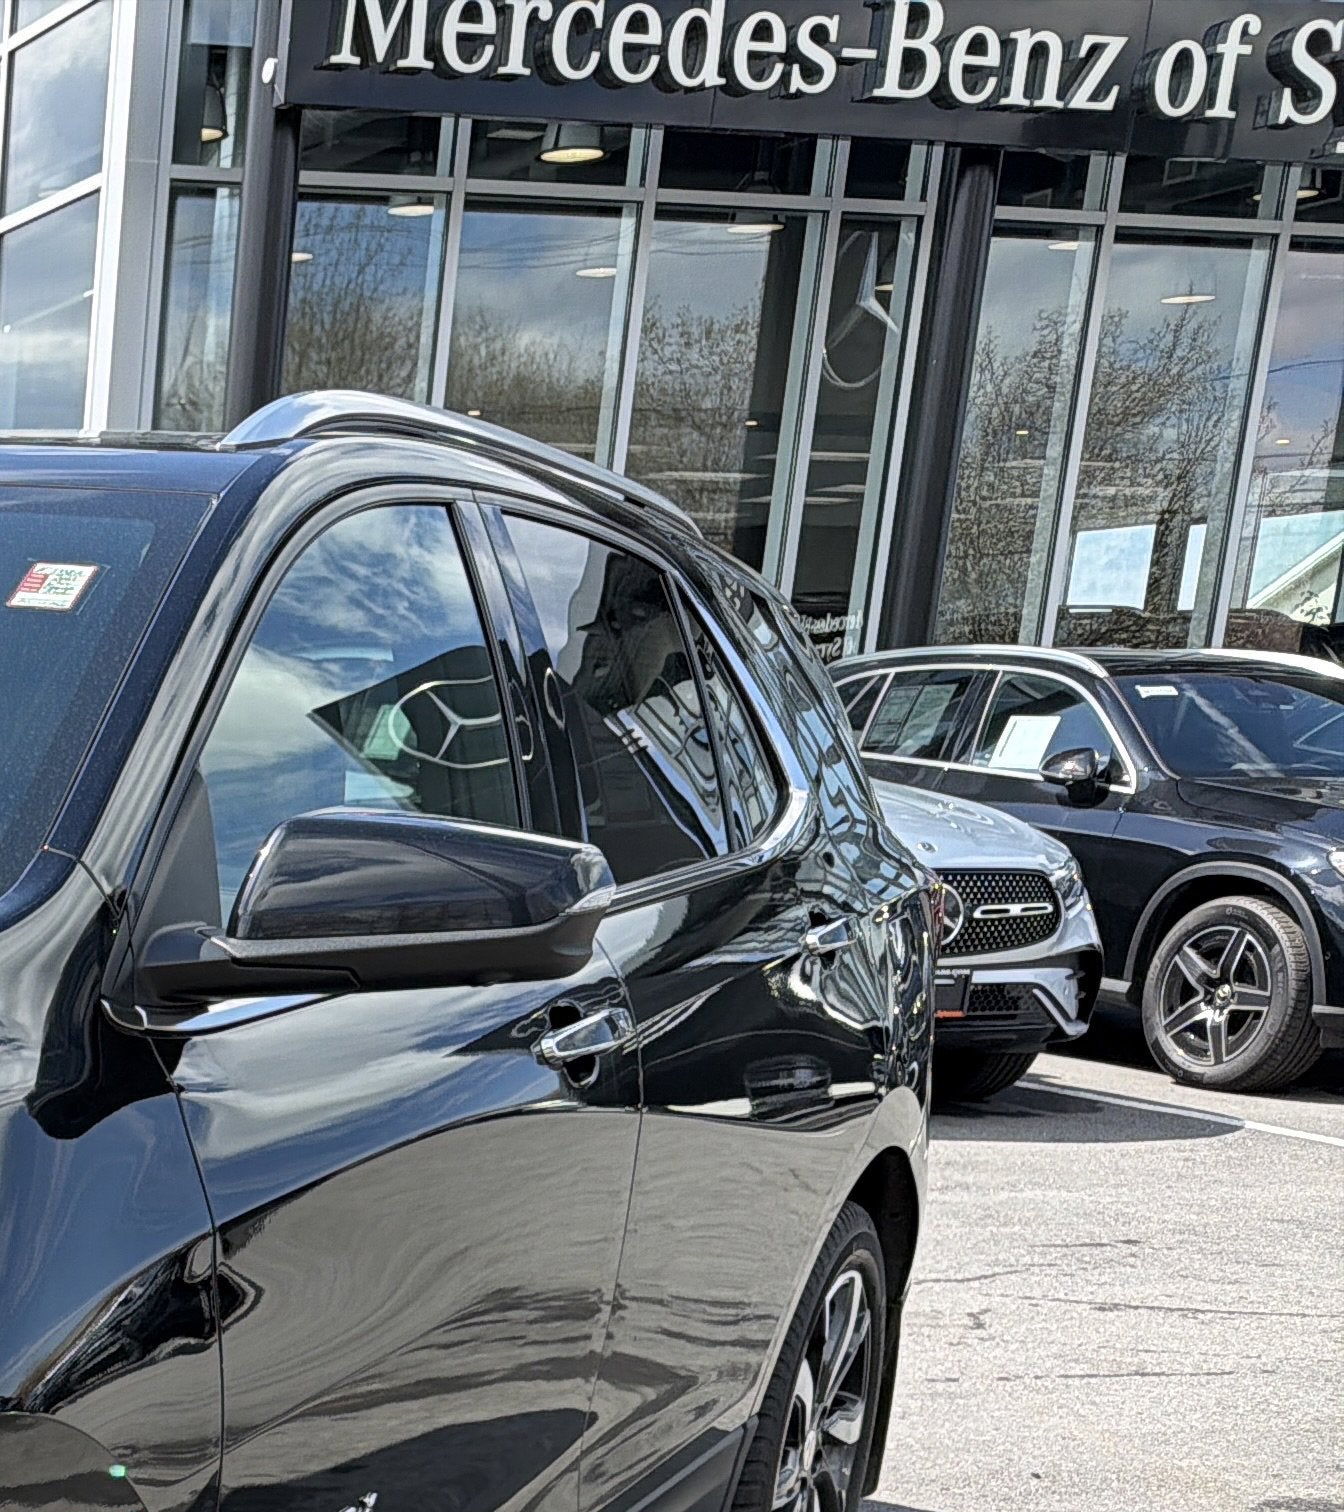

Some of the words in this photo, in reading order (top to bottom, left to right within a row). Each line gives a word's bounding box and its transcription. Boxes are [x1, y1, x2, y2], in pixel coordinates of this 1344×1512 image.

[328, 0, 1130, 111] Mercedes-Benz
[1155, 13, 1262, 120] of
[1278, 18, 1344, 127] S
